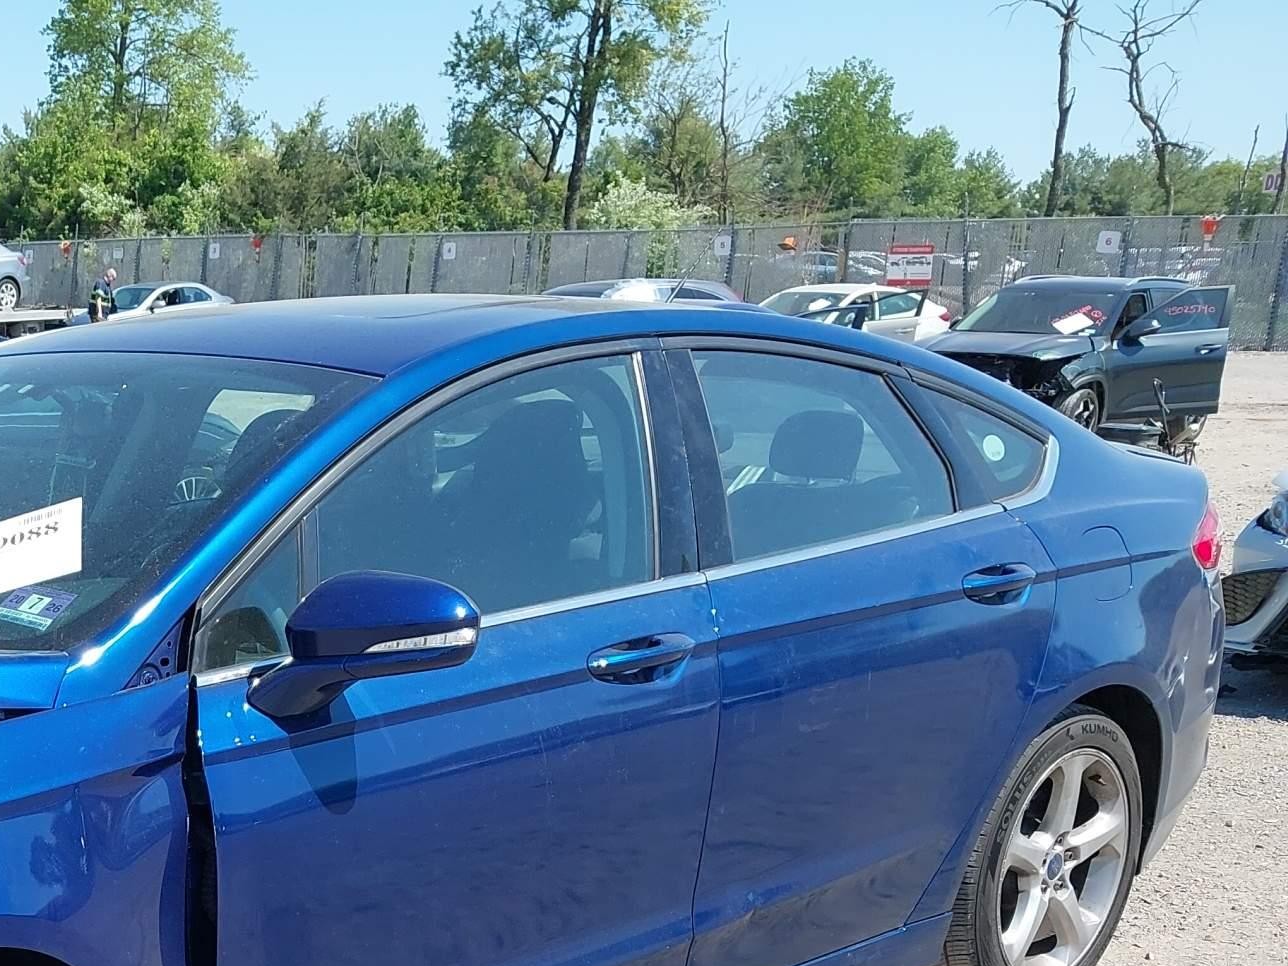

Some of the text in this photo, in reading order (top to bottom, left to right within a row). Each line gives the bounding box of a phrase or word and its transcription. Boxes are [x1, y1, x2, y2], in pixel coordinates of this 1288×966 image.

[1104, 237, 1113, 246] 6
[9, 594, 63, 613] 20 7 26
[1081, 723, 1119, 743] KUMHO
